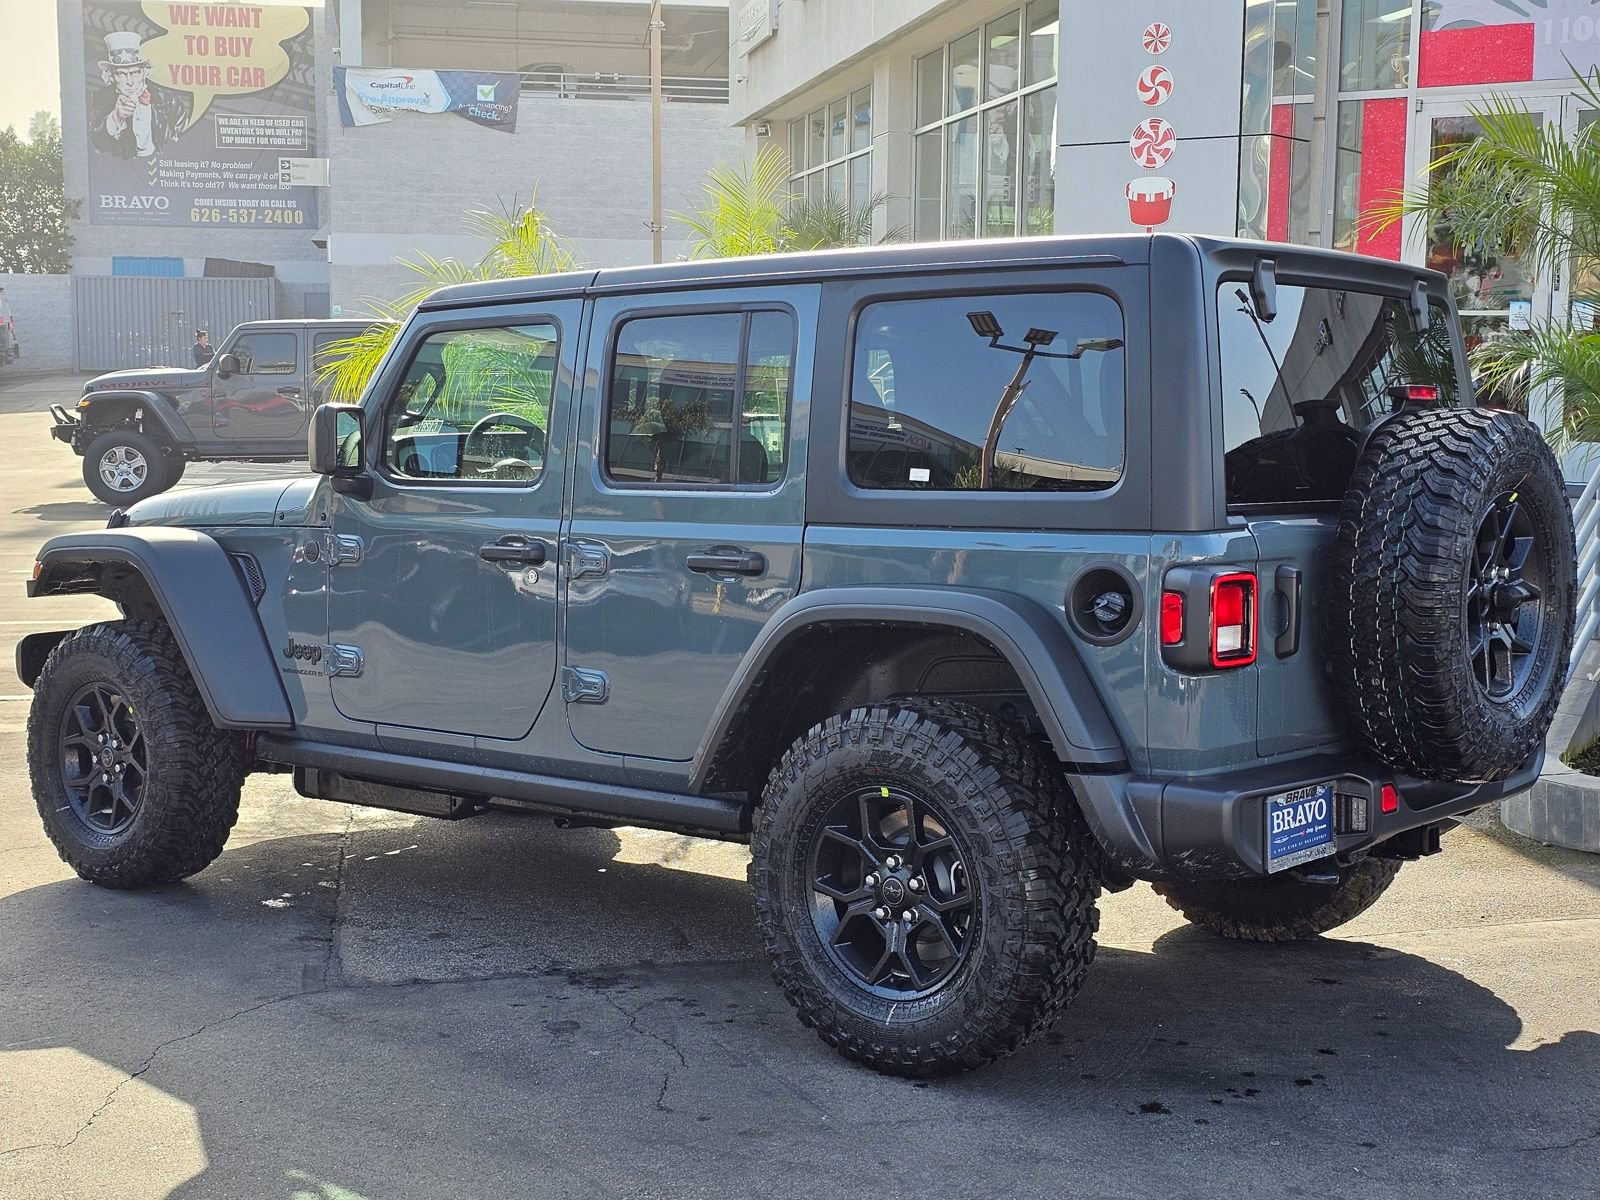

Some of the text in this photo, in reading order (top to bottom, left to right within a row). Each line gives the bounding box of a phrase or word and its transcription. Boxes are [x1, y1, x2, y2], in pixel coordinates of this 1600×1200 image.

[168, 4, 262, 28] WE WANT
[1543, 15, 1600, 44] 110
[184, 35, 253, 57] TO BUY
[168, 64, 265, 87] YOUR CAR
[358, 92, 430, 105] Pre-Approval
[468, 106, 500, 120] Check.
[229, 118, 241, 126] ARE
[265, 119, 274, 127] OF
[255, 128, 265, 136] SO
[265, 128, 276, 136] WE
[256, 137, 269, 145] FOR
[174, 160, 199, 169] leasing
[222, 161, 253, 170] problem!
[160, 170, 185, 179] Making
[180, 180, 191, 188] it's
[205, 181, 225, 189] old??
[99, 194, 169, 209] BRAVO
[194, 198, 297, 209] COME INSIDE TODAY OR CALL US
[190, 208, 304, 225] 626-537-2400
[283, 637, 322, 665] Jeep
[1272, 798, 1327, 834] BRAVO
